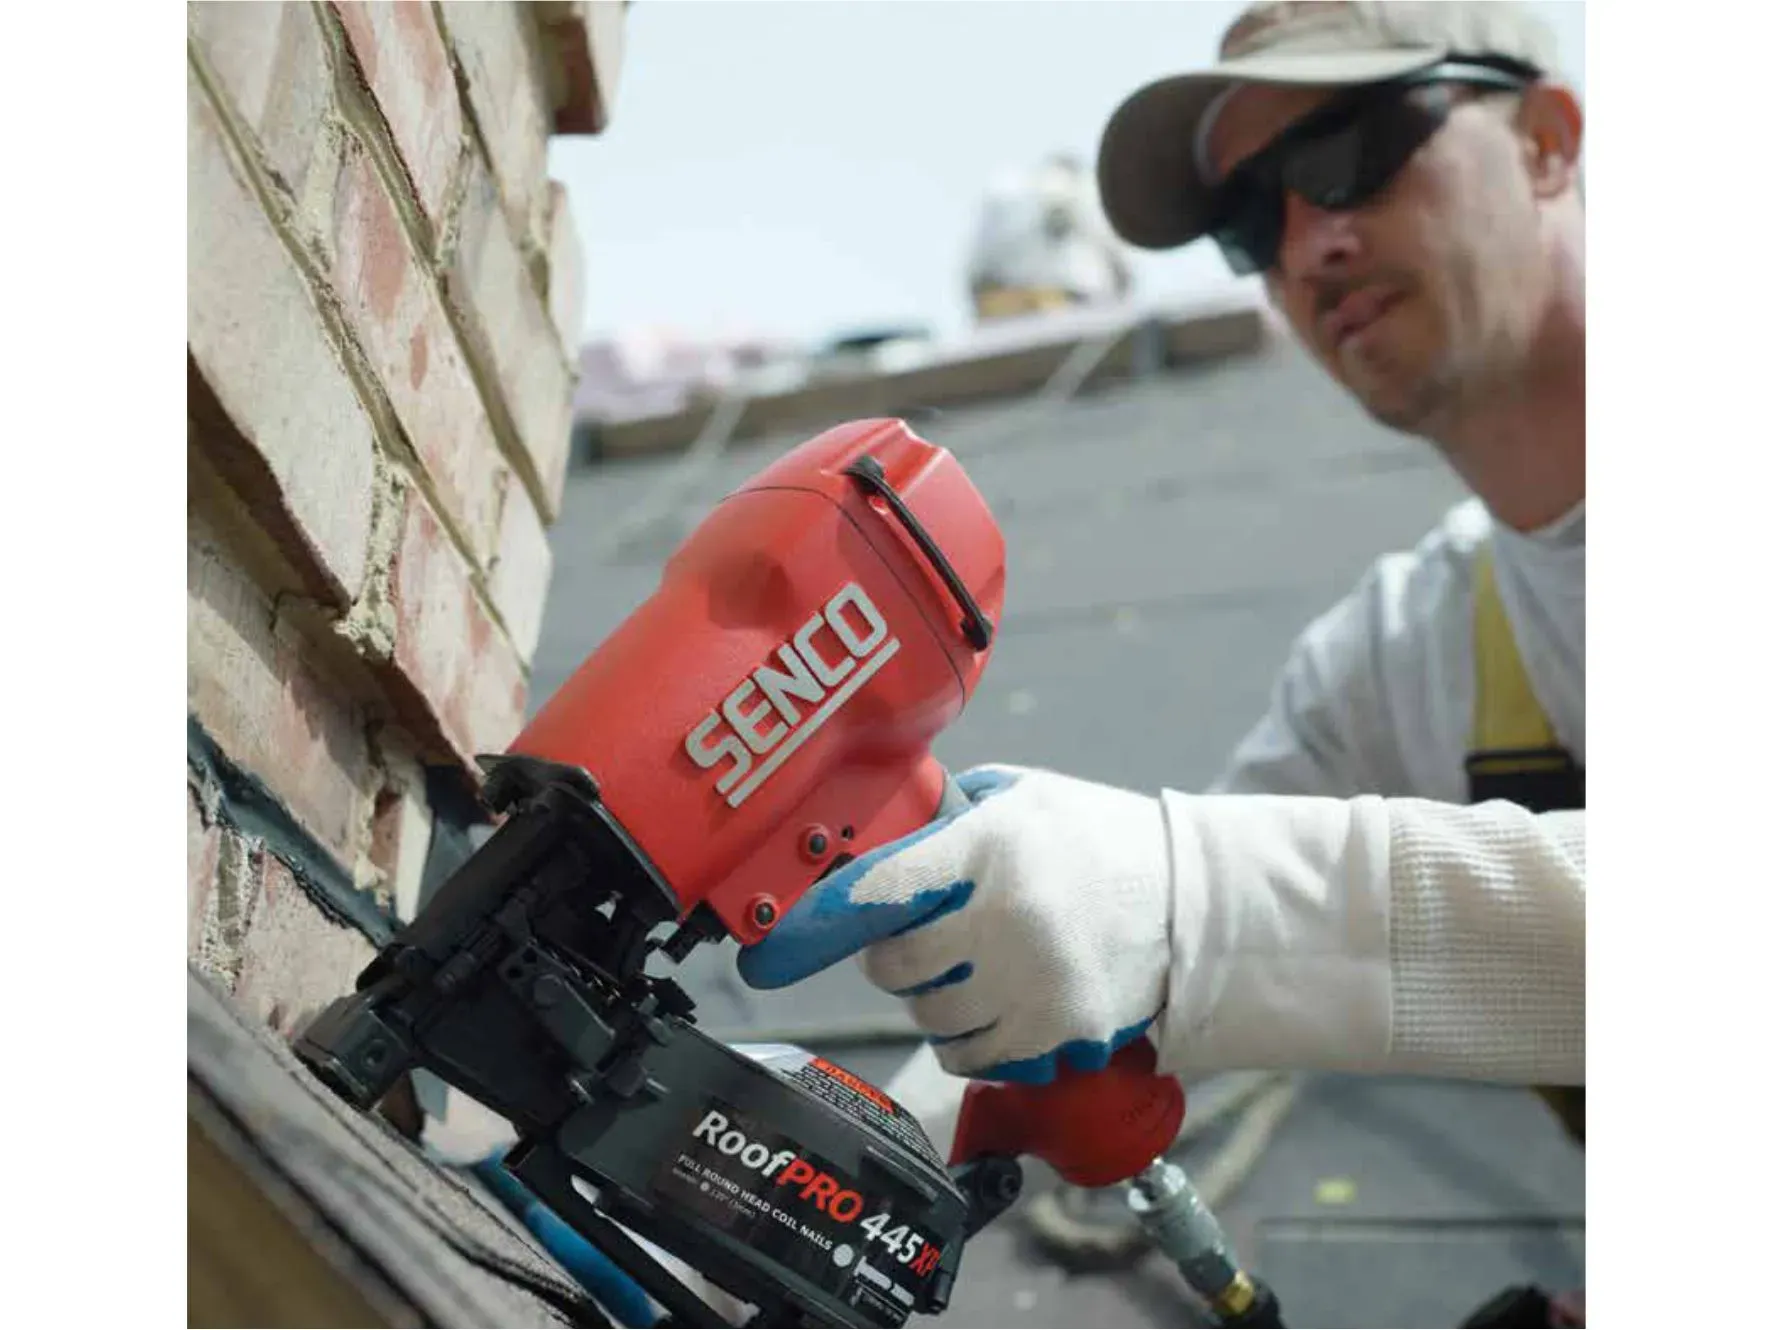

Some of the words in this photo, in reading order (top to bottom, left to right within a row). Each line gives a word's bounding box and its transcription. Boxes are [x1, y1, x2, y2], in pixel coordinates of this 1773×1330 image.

[685, 580, 888, 793] SENCO
[702, 1168, 740, 1194] ROUND
[741, 1189, 771, 1213] HEAD
[772, 1208, 798, 1231] COIL
[799, 1225, 833, 1250] NAILS
